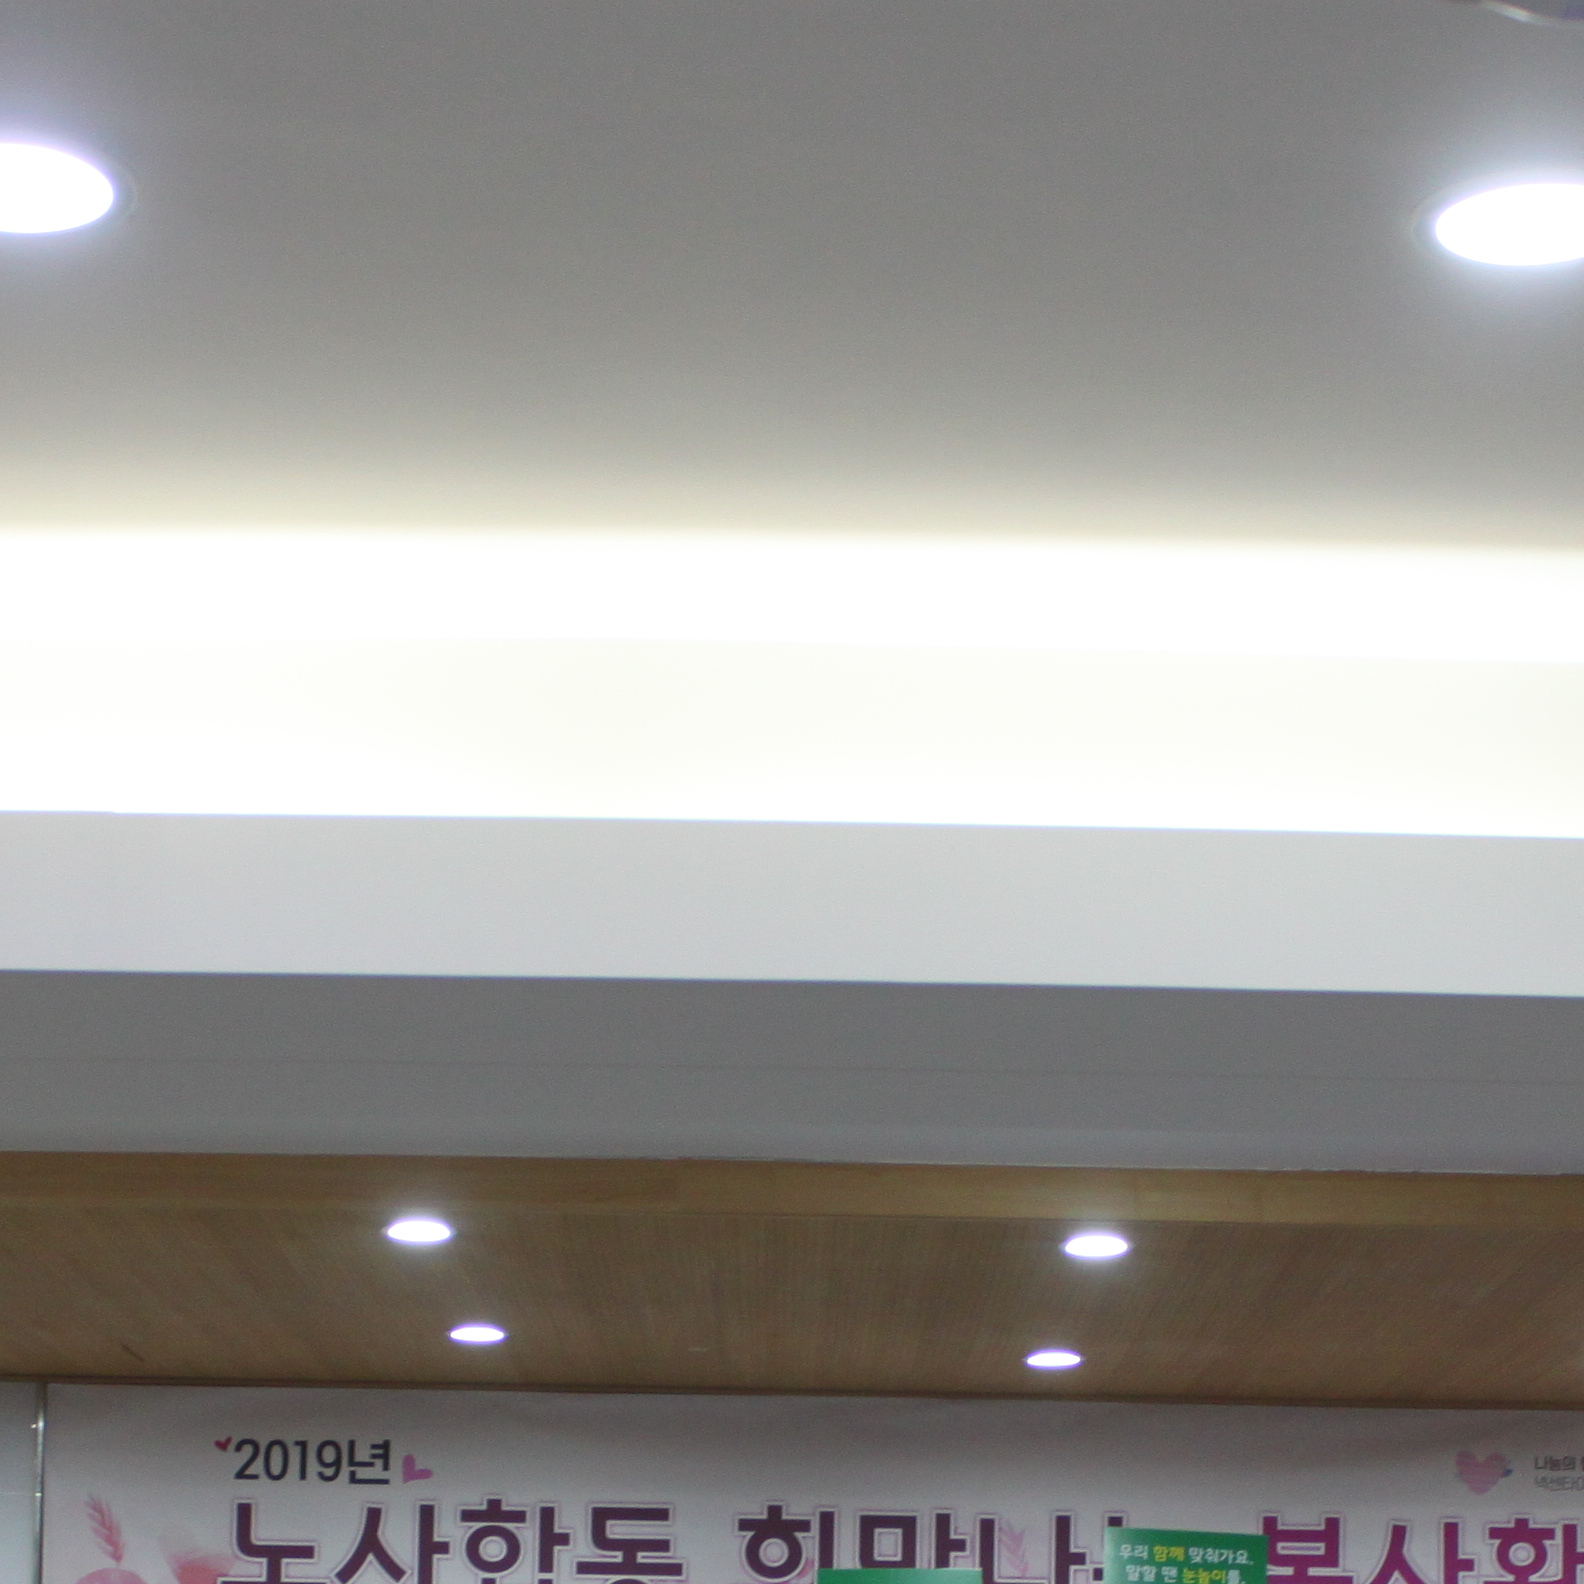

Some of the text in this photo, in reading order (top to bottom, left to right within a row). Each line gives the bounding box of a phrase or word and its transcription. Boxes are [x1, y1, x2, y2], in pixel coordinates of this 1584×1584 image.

[234, 1438, 392, 1485] 2019년
[1119, 1544, 1185, 1562] 우리 함께
